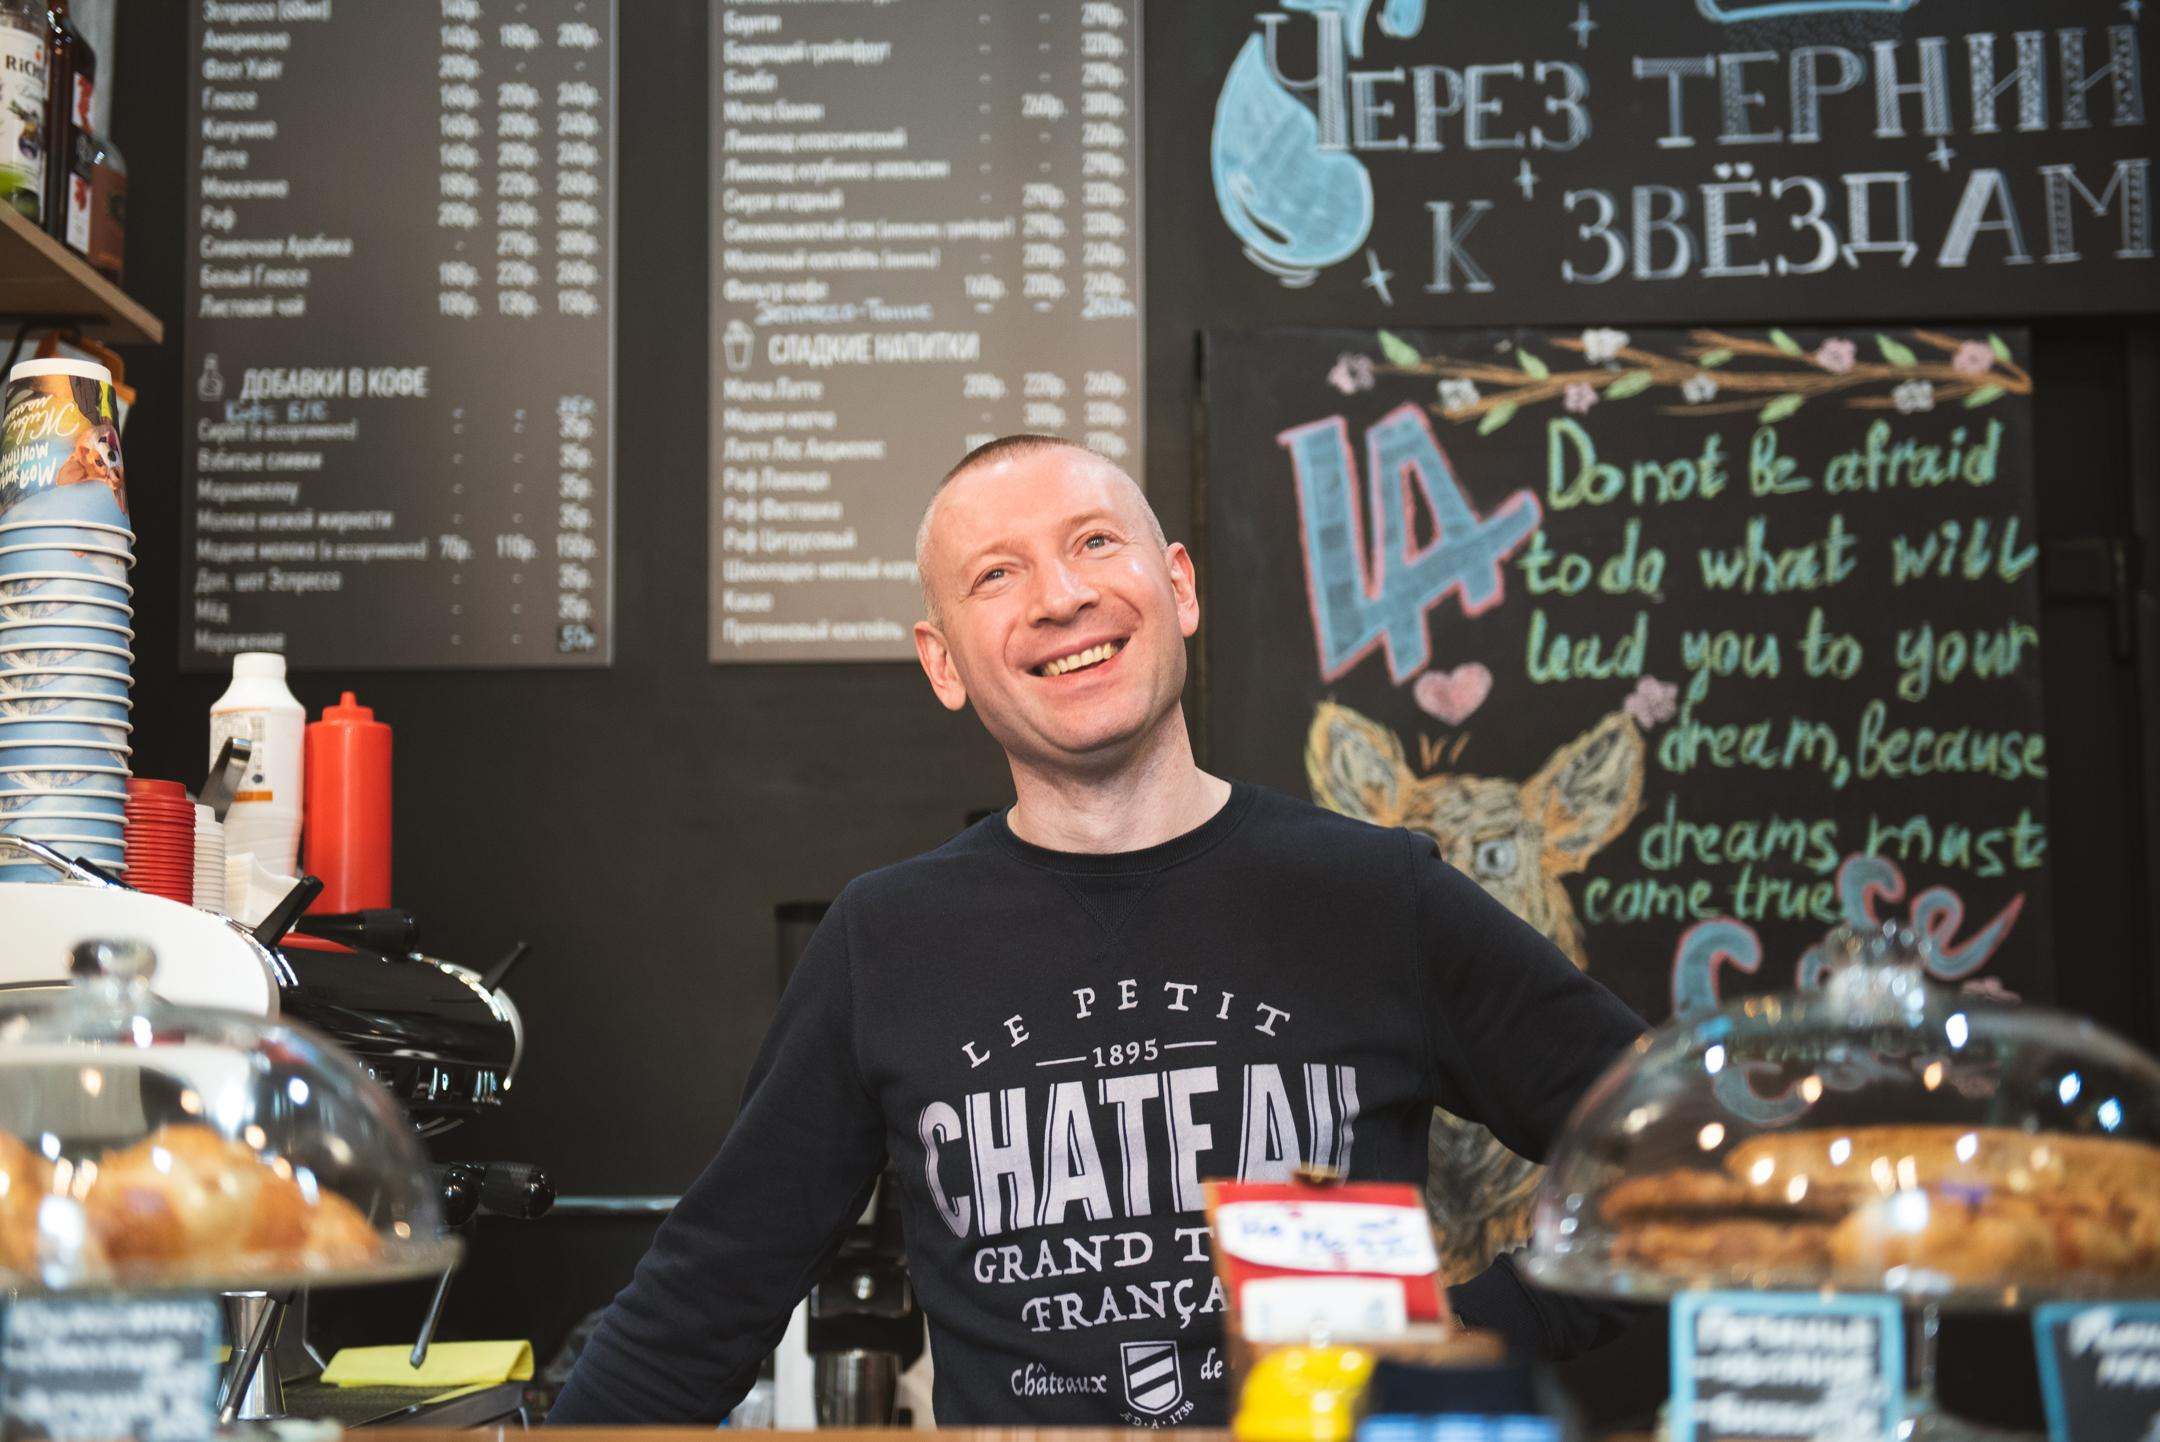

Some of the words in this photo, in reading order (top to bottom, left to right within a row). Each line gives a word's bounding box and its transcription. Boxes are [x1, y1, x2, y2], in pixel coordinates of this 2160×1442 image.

[1256, 11, 1592, 151] ЧЕРЕЗ
[1633, 25, 2143, 148] ТЕРНИИ
[1426, 201, 1493, 292] К
[1562, 159, 2153, 284] ЗВЁЗДАМ
[240, 367, 344, 401] ДОБАВКИ
[349, 368, 364, 398] В
[368, 367, 429, 398] КОФЕ
[768, 334, 872, 367] СЛАДКИЕ
[875, 332, 980, 361] НАПИТКИ
[1825, 418, 2003, 494] afraid
[1699, 515, 1857, 592] what
[1892, 517, 2038, 585] will
[1526, 609, 1648, 684] lead
[1682, 630, 1781, 702] you
[1800, 607, 1862, 679] to
[1897, 622, 2038, 701] your
[1640, 794, 1841, 872] dreams
[1866, 809, 2048, 877] must
[1584, 876, 1719, 922] come
[962, 1014, 1029, 1068] LE
[1073, 979, 1291, 1037] PETIT
[1092, 1039, 1160, 1068] 1895
[917, 1063, 1360, 1239] CHATEAU
[974, 1231, 1153, 1285] GRAND
[1022, 1276, 1230, 1332] FRANÇA
[1011, 1362, 1107, 1396] Châteaux
[1200, 1347, 1223, 1380] de
